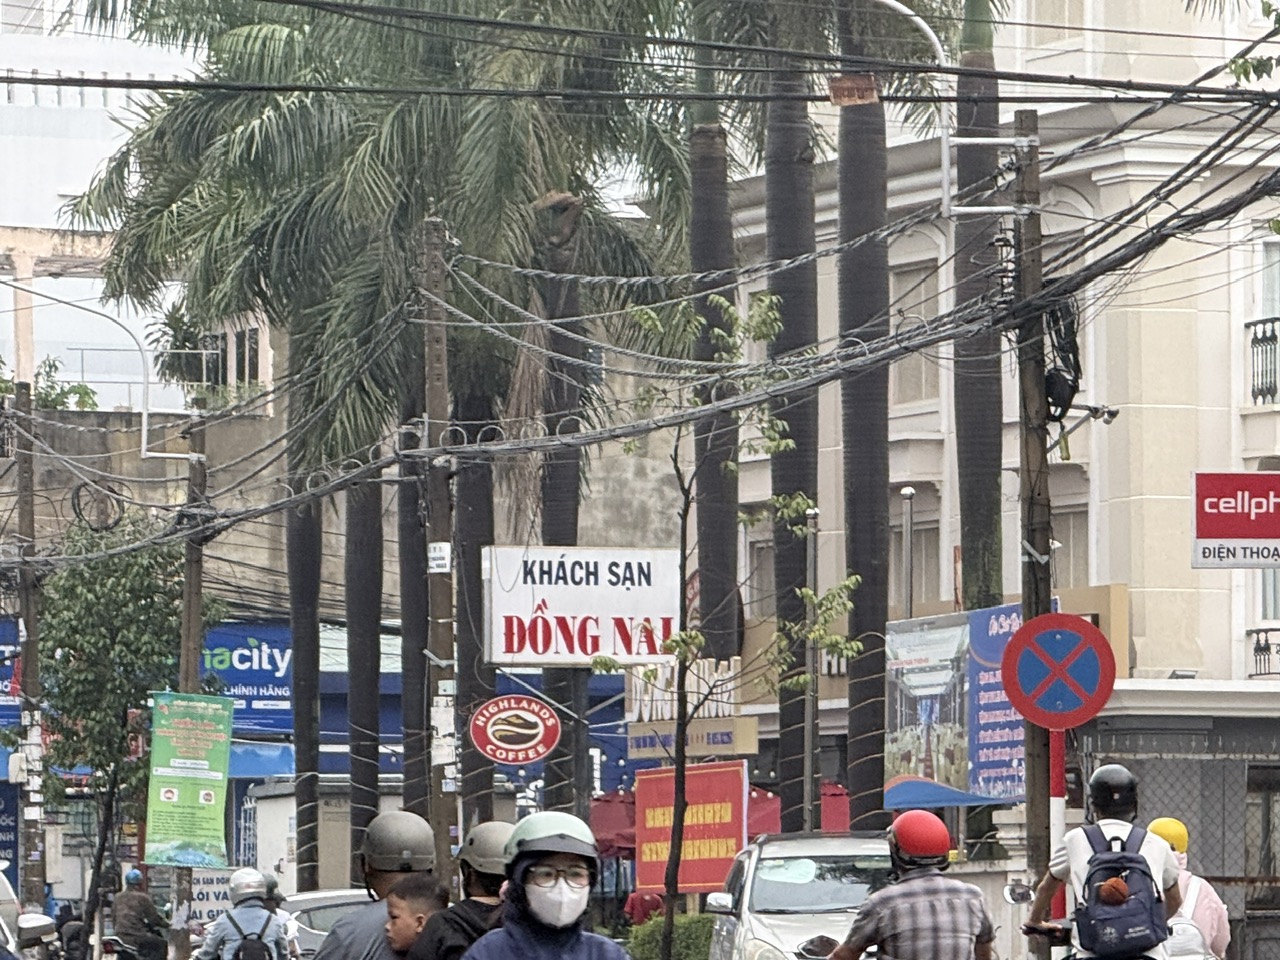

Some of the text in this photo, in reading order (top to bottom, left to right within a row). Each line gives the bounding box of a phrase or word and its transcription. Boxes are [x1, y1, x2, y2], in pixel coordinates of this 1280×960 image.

[1202, 543, 1237, 562] ĐIỆN
[523, 553, 652, 591] KHÁCH SẠN
[502, 598, 676, 656] ĐỒNG NAI
[259, 684, 291, 697] HÃNG
[475, 698, 557, 728] HIGHLANDS
[485, 744, 547, 763] COFFEE
